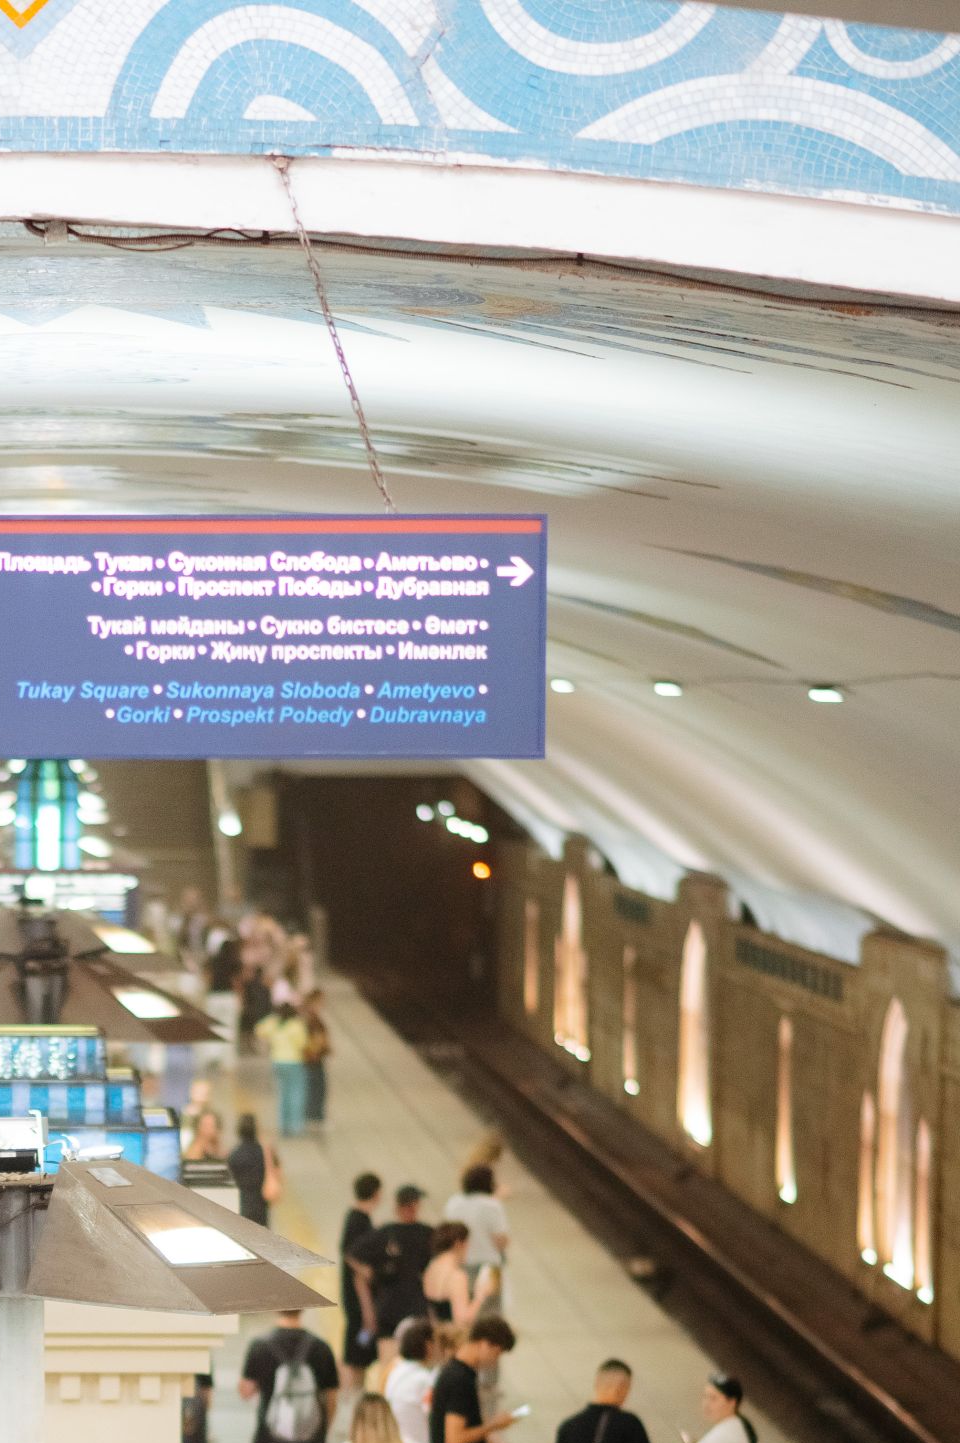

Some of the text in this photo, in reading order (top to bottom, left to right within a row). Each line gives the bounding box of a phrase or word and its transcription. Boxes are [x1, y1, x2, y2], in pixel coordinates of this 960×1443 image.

[167, 550, 268, 576] Суконная
[269, 550, 362, 574] Слобода
[103, 575, 489, 600] Горки Проспект Победы Дубравная
[86, 615, 146, 640] Тукай
[260, 615, 323, 639] Сукно
[136, 641, 196, 664] Горки
[271, 645, 383, 664] проспекты
[16, 681, 476, 703] Tukay Square Sukonnaya Sloboda Ametyevo
[116, 706, 487, 728] Gorki Prospekt Pobedy Dubravnaya
